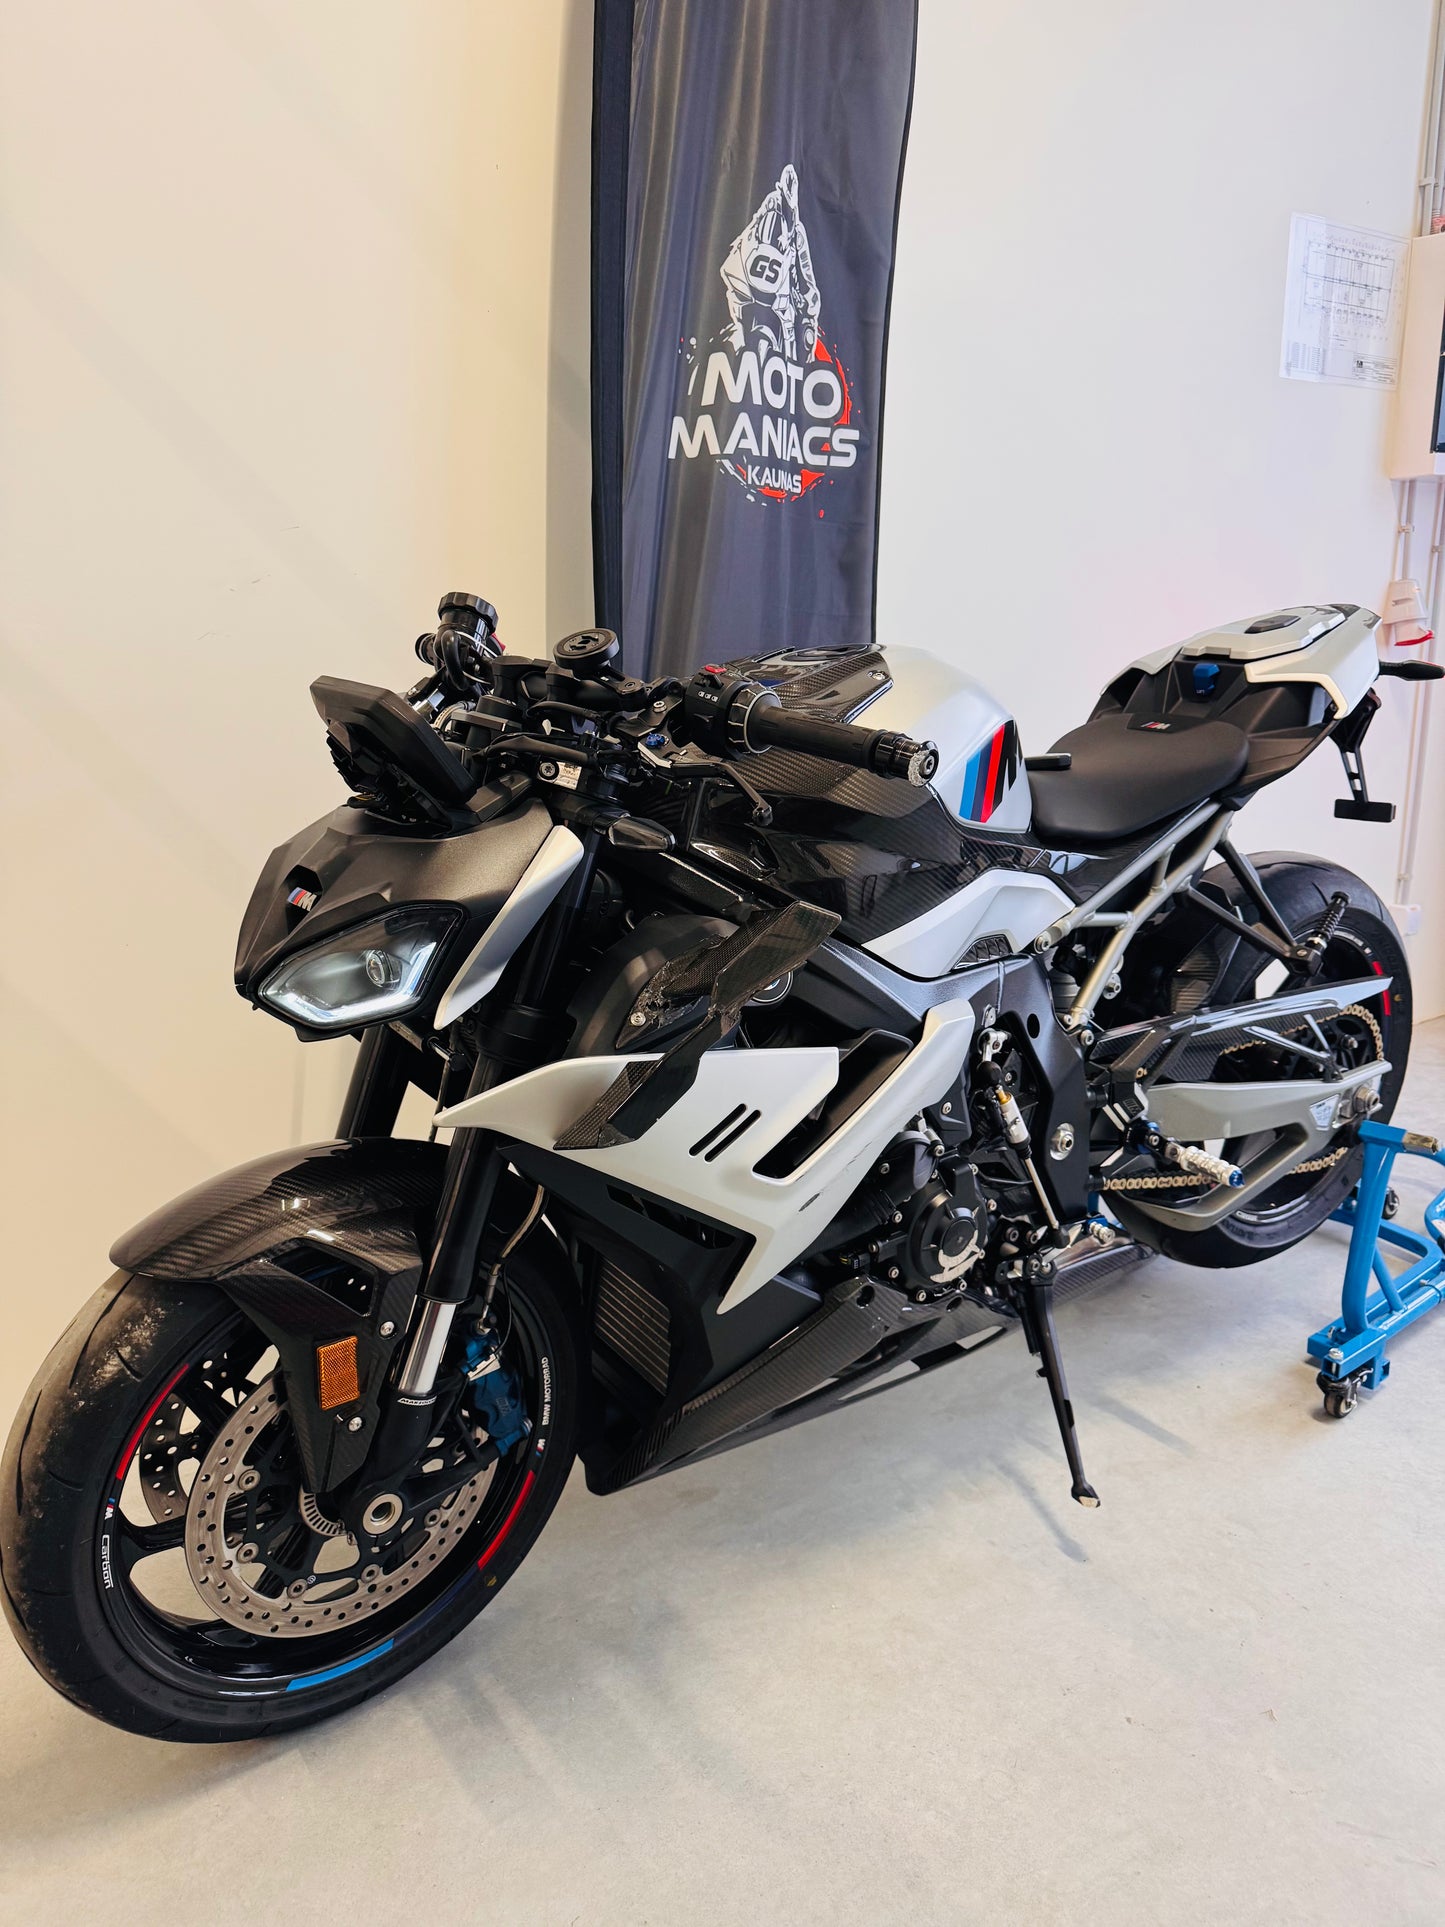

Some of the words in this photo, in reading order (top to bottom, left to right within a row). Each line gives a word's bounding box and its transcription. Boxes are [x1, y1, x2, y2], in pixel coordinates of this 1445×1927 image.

[749, 254, 782, 284] GS
[701, 351, 842, 419] MOTO
[668, 412, 860, 468] MANIACS
[747, 465, 802, 493] KAUNAS
[542, 1357, 552, 1402] MOTORRAD
[542, 1404, 551, 1426] BMW
